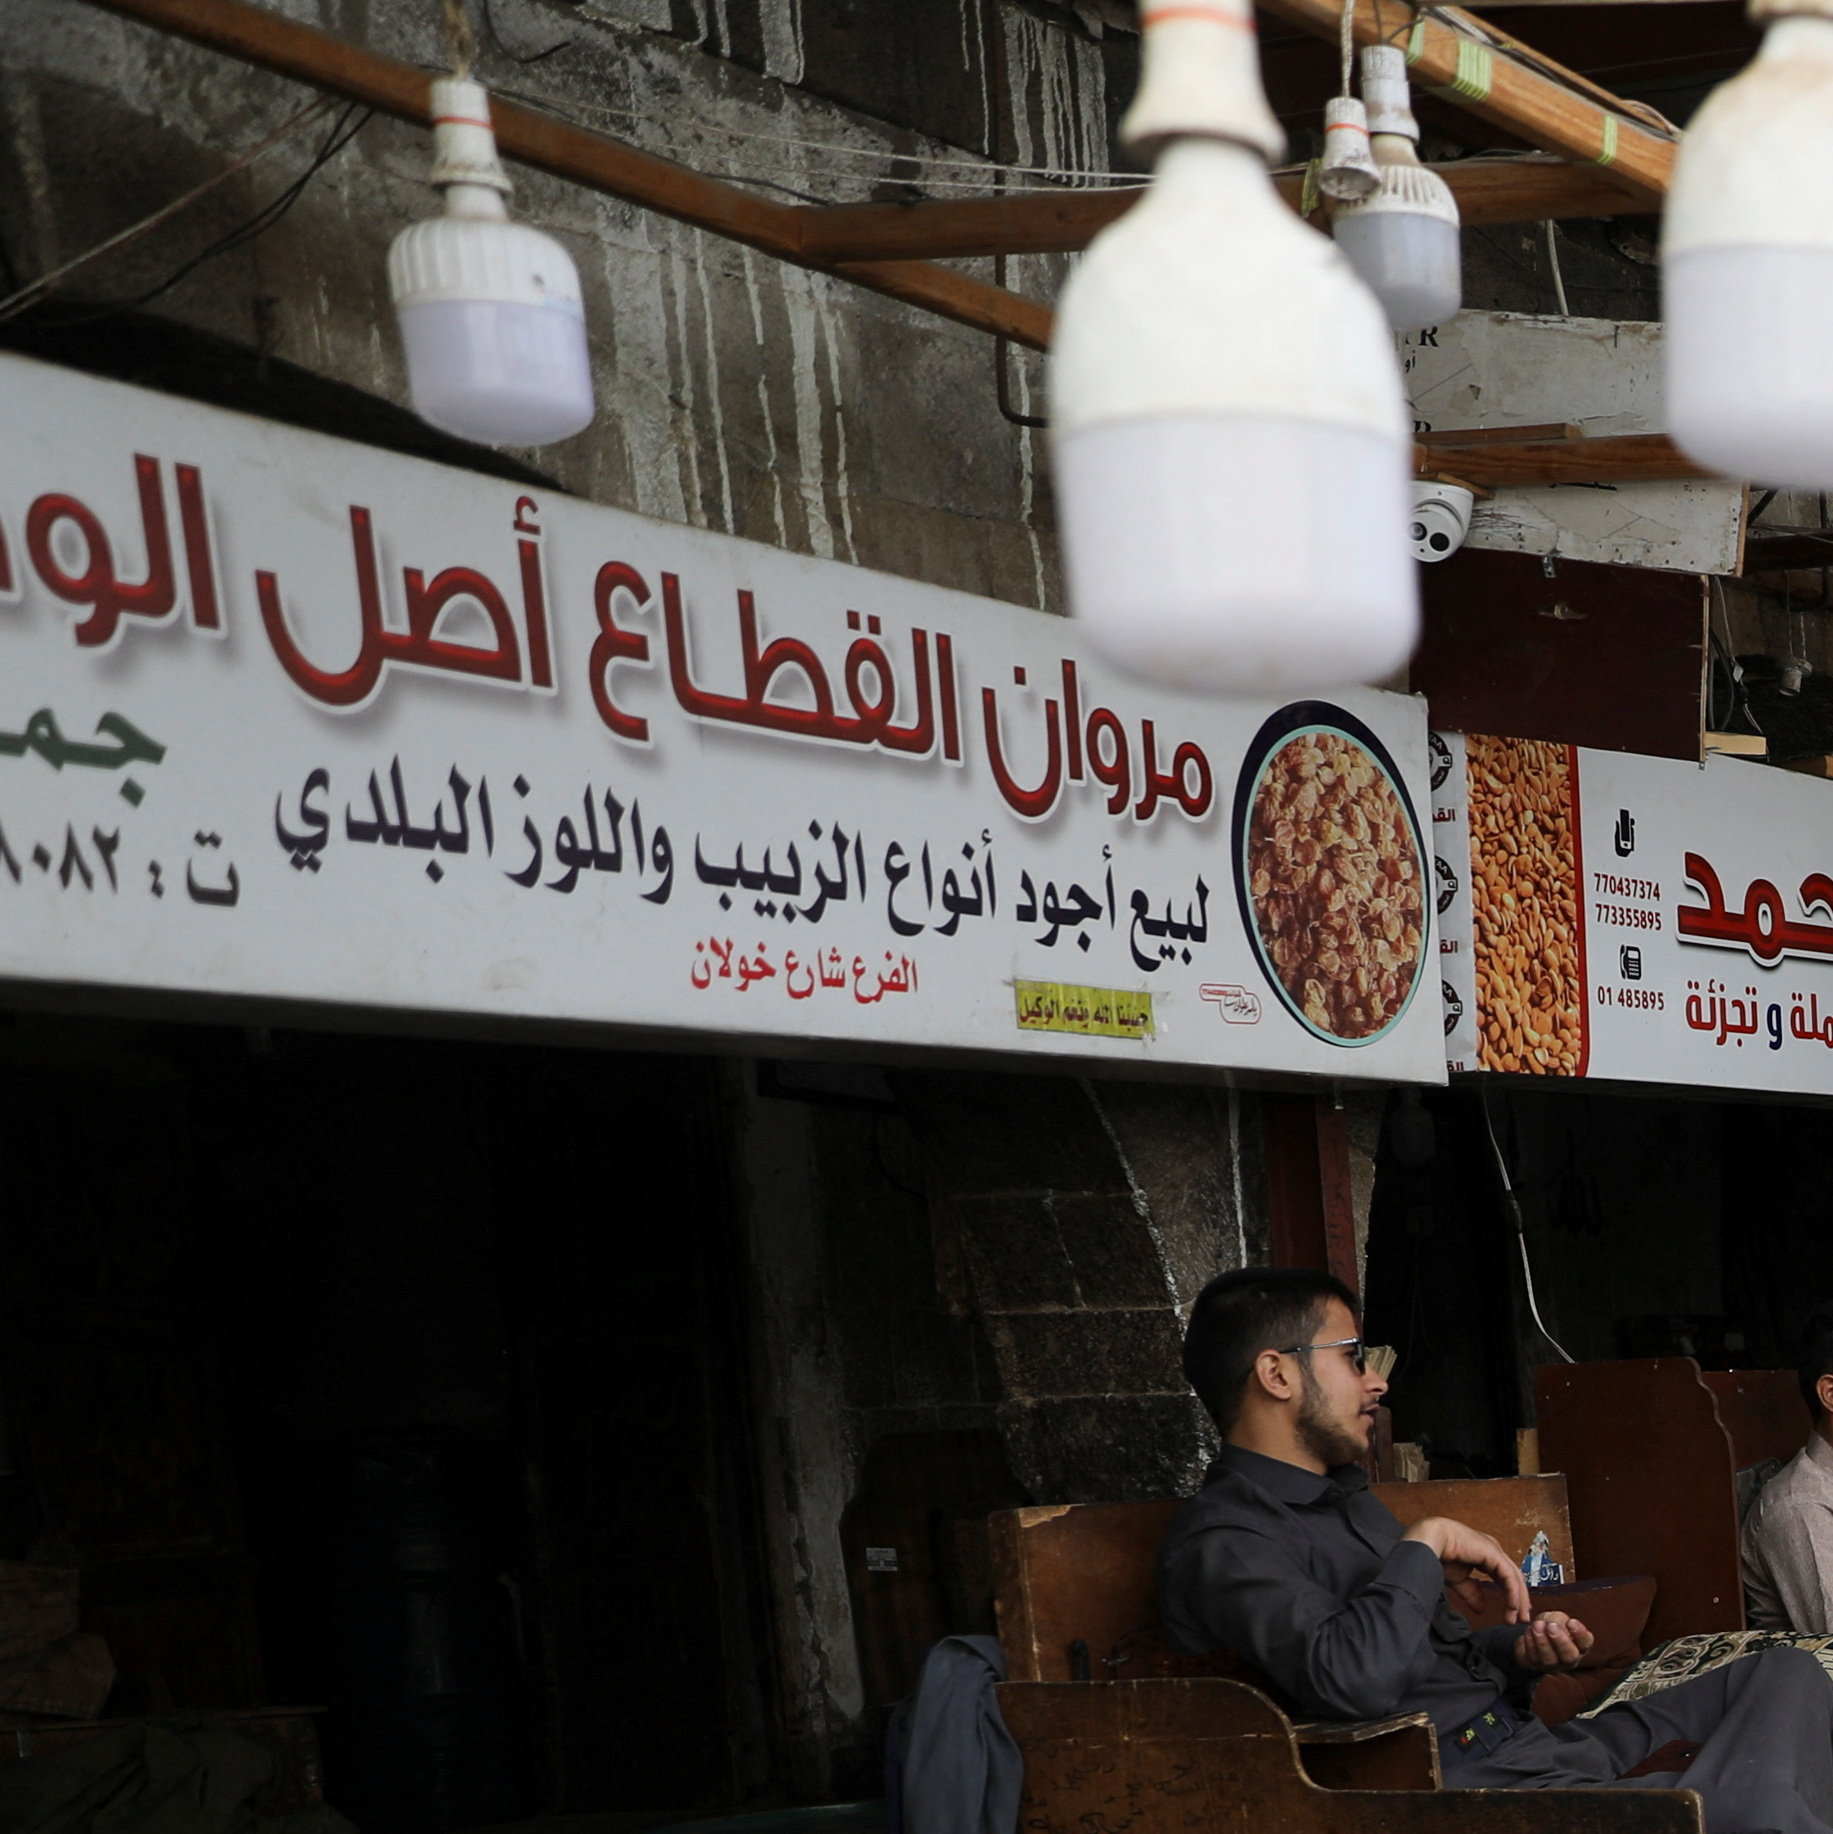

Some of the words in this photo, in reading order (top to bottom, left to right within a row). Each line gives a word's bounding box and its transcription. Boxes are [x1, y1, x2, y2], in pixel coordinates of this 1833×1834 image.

[0, 452, 220, 647] الو
[255, 496, 553, 706] أصل
[589, 560, 961, 762] القطاع
[0, 709, 167, 808] جم
[981, 659, 1214, 820] مروان
[275, 755, 494, 883] البلدي
[506, 775, 674, 905] واللوز
[695, 820, 866, 923] الزبيب
[885, 828, 996, 937] أنواع
[1015, 844, 1116, 951] أجود
[1594, 872, 1661, 902] 770437374
[1595, 903, 1662, 931] 773355895
[691, 936, 776, 992] خولان
[1128, 873, 1210, 972] لبيع
[785, 946, 845, 1000] شارع
[852, 950, 917, 1004] الفرع
[1019, 994, 1060, 1024] الوكيل
[1094, 1002, 1114, 1026] الله
[1597, 986, 1613, 1006] 01
[1618, 988, 1665, 1011] 485895
[1686, 978, 1758, 1047] تجزئة
[1767, 1003, 1783, 1050] و
